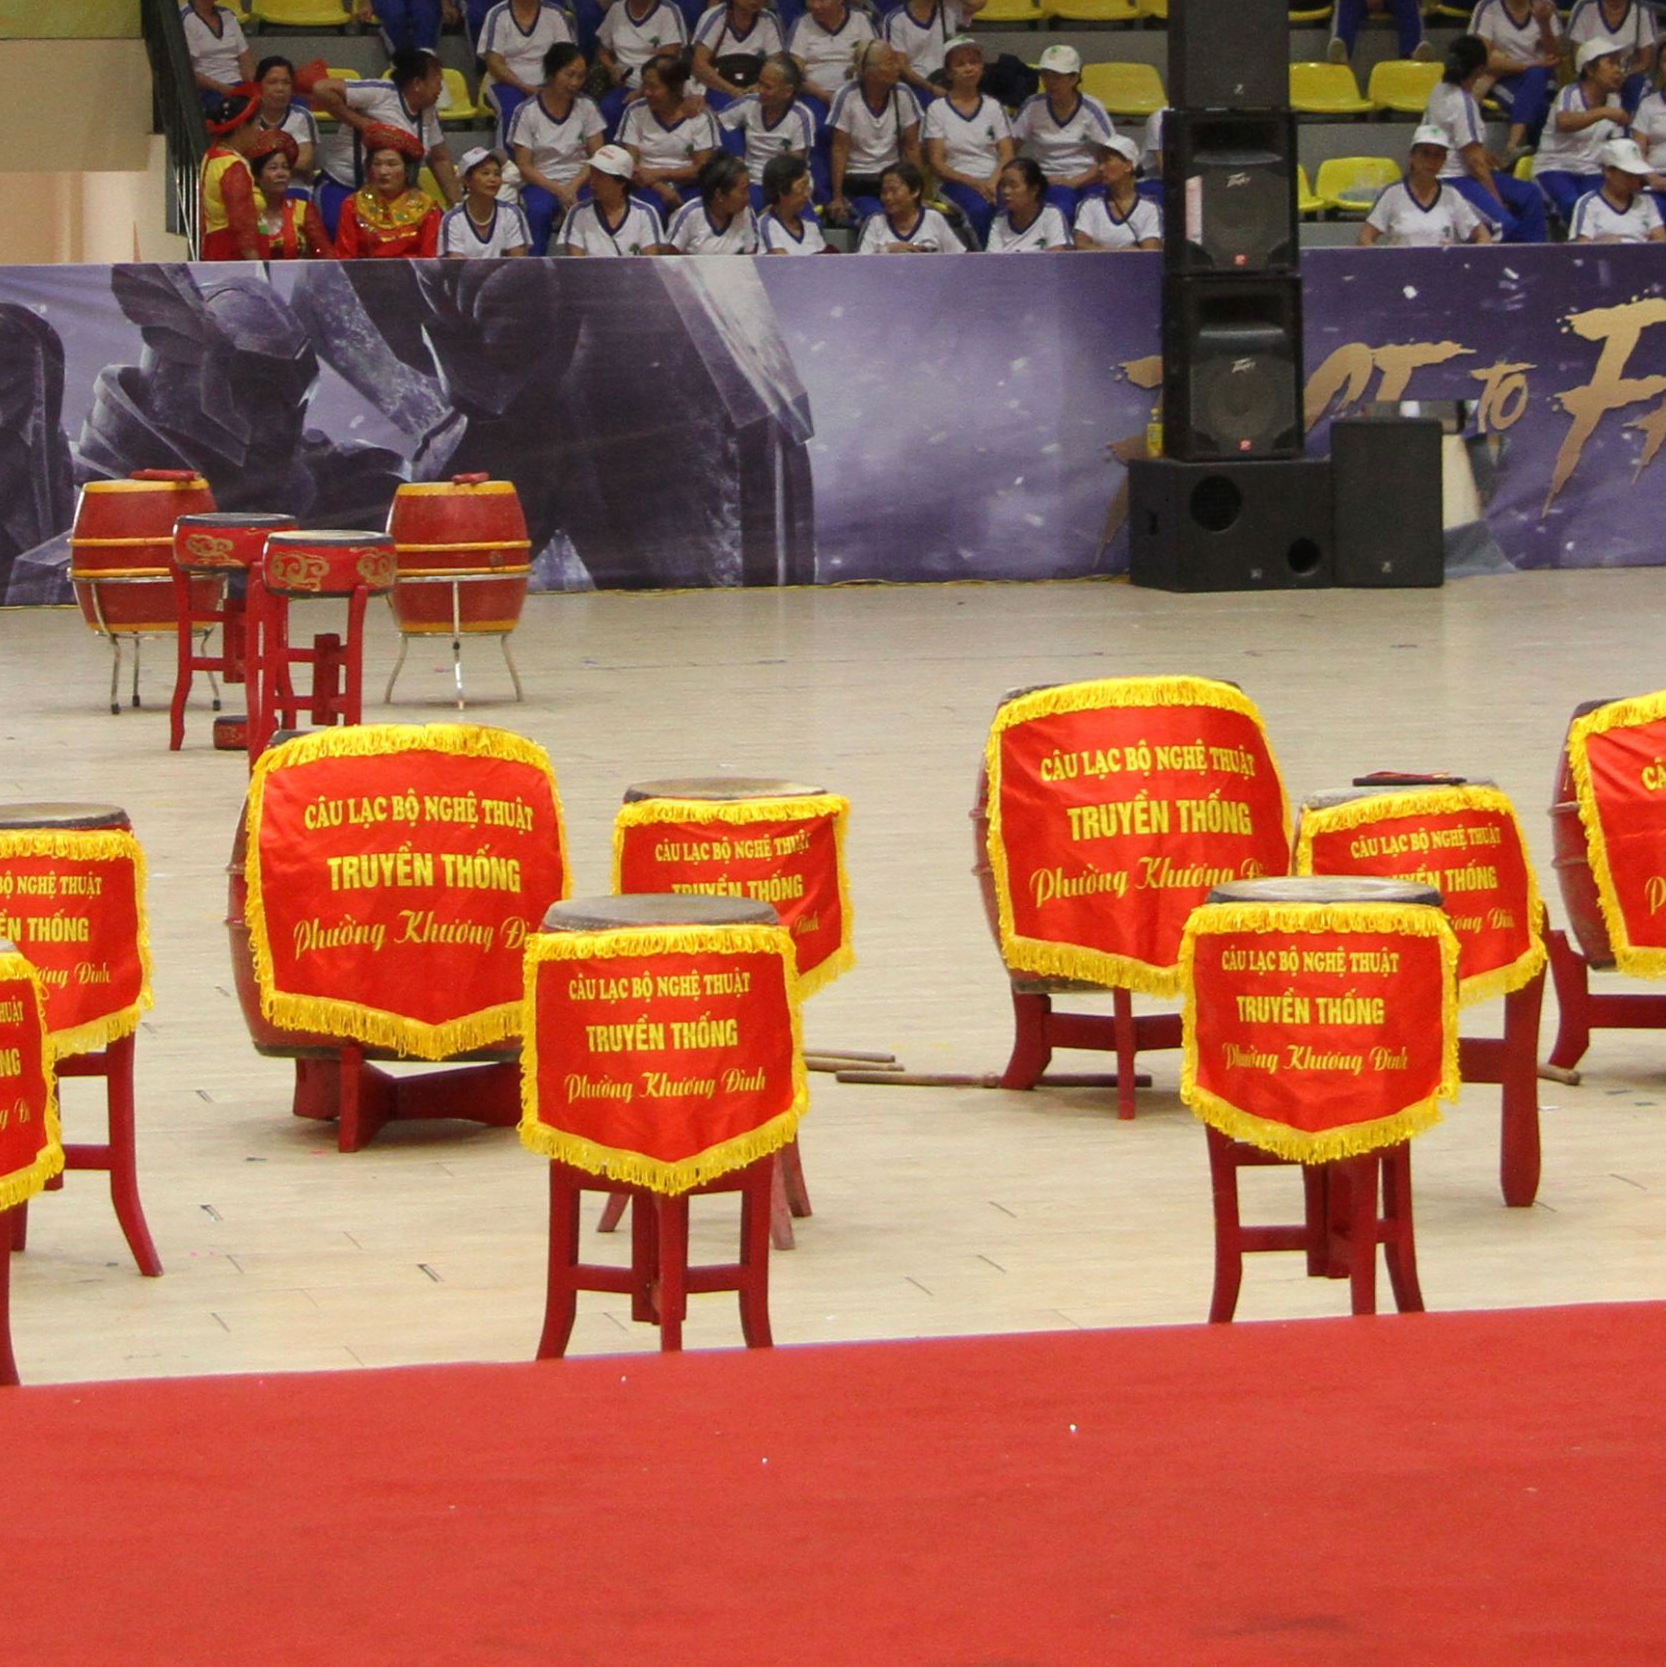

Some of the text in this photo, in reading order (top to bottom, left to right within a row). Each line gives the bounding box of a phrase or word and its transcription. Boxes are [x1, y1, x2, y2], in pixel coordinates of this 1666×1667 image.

[1471, 358, 1537, 432] TO
[305, 788, 533, 834] CÂU LẠC BỘ NGHỆ THUẬT
[327, 840, 521, 893] TRUYỀN THỐNG
[294, 914, 386, 960] Phường
[394, 910, 494, 952] Khương
[1222, 945, 1399, 977] CÂU LẠC BỘ NGHỆ THUẬT
[569, 967, 750, 1004] CÂU LẠC BỘ NGHỆ THUẬT
[1237, 988, 1385, 1024] TRUYỀN THỐNG
[586, 1011, 738, 1052] TRUYỀN THỐNG
[1283, 1045, 1363, 1075] Khương
[565, 1073, 632, 1104] Phường
[640, 1072, 715, 1099] Khương
